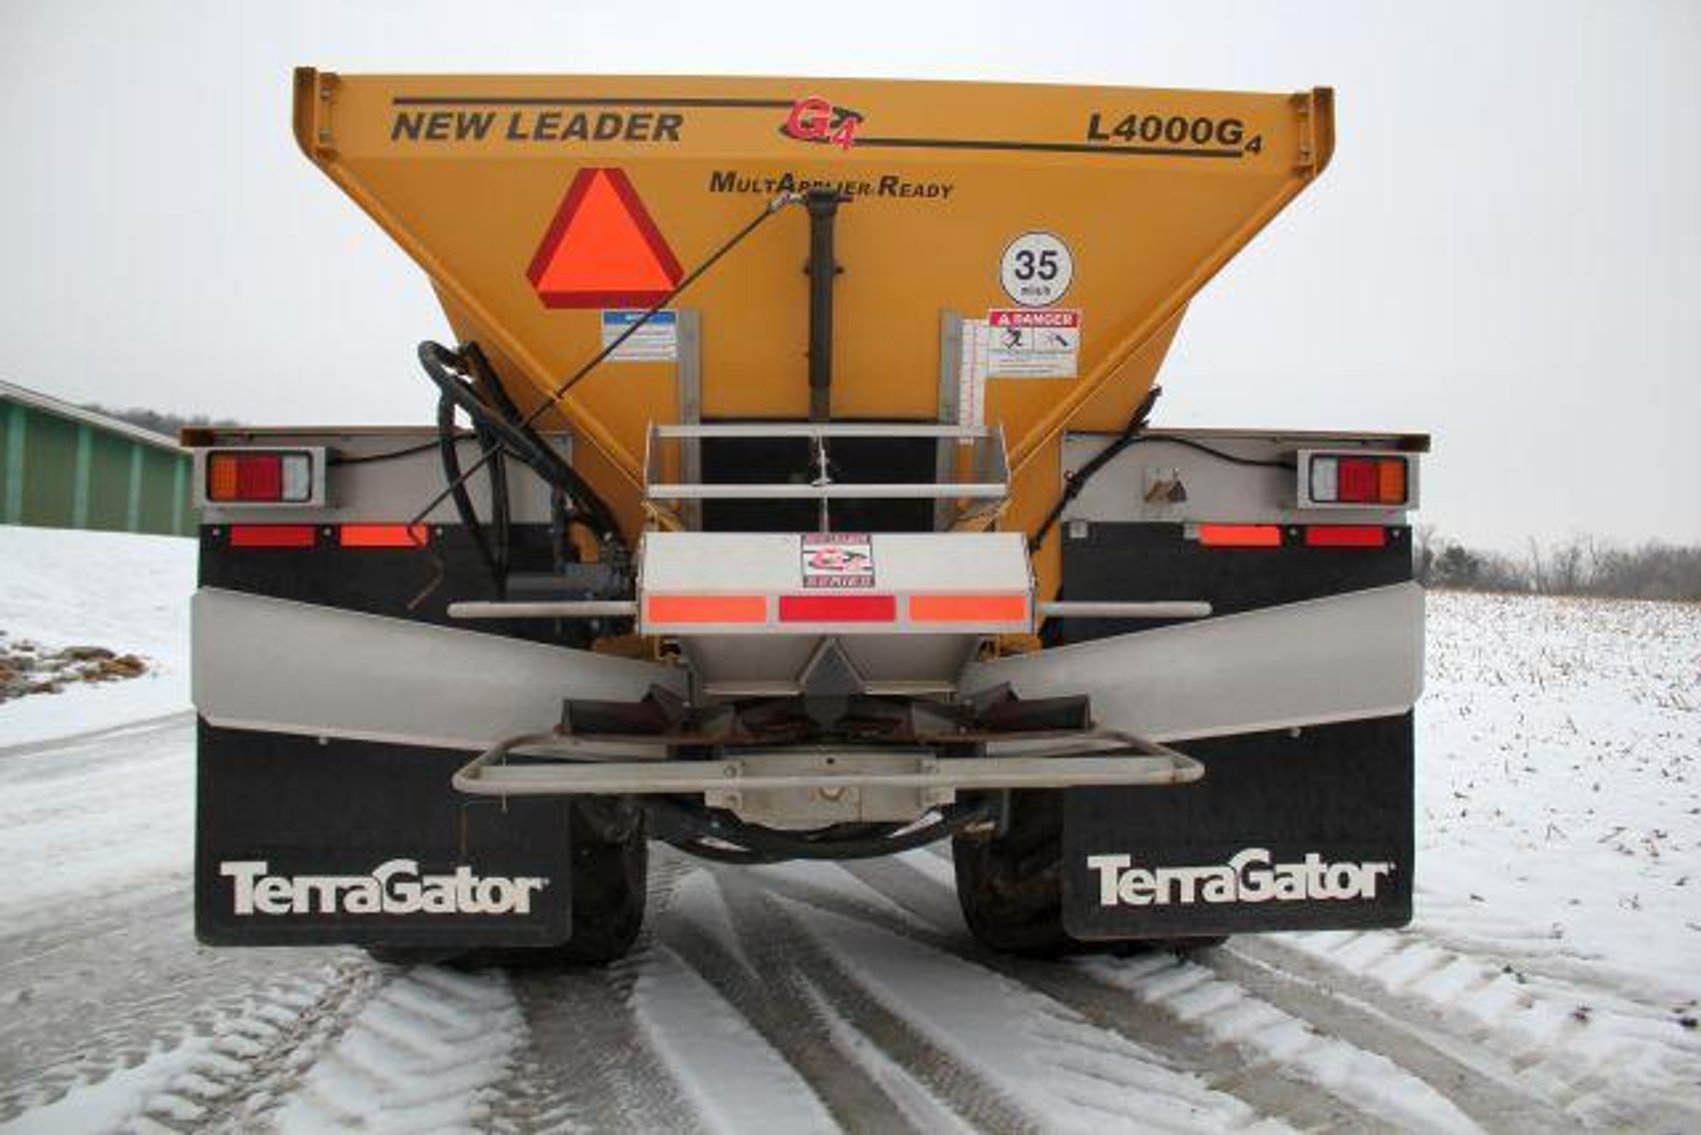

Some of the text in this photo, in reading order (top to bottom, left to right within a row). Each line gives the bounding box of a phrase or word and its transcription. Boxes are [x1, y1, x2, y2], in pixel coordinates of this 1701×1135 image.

[391, 111, 684, 142] NEW LEADER
[1014, 250, 1058, 280] 35
[220, 858, 546, 914] TerraGator
[1087, 848, 1390, 905] TerraGator
